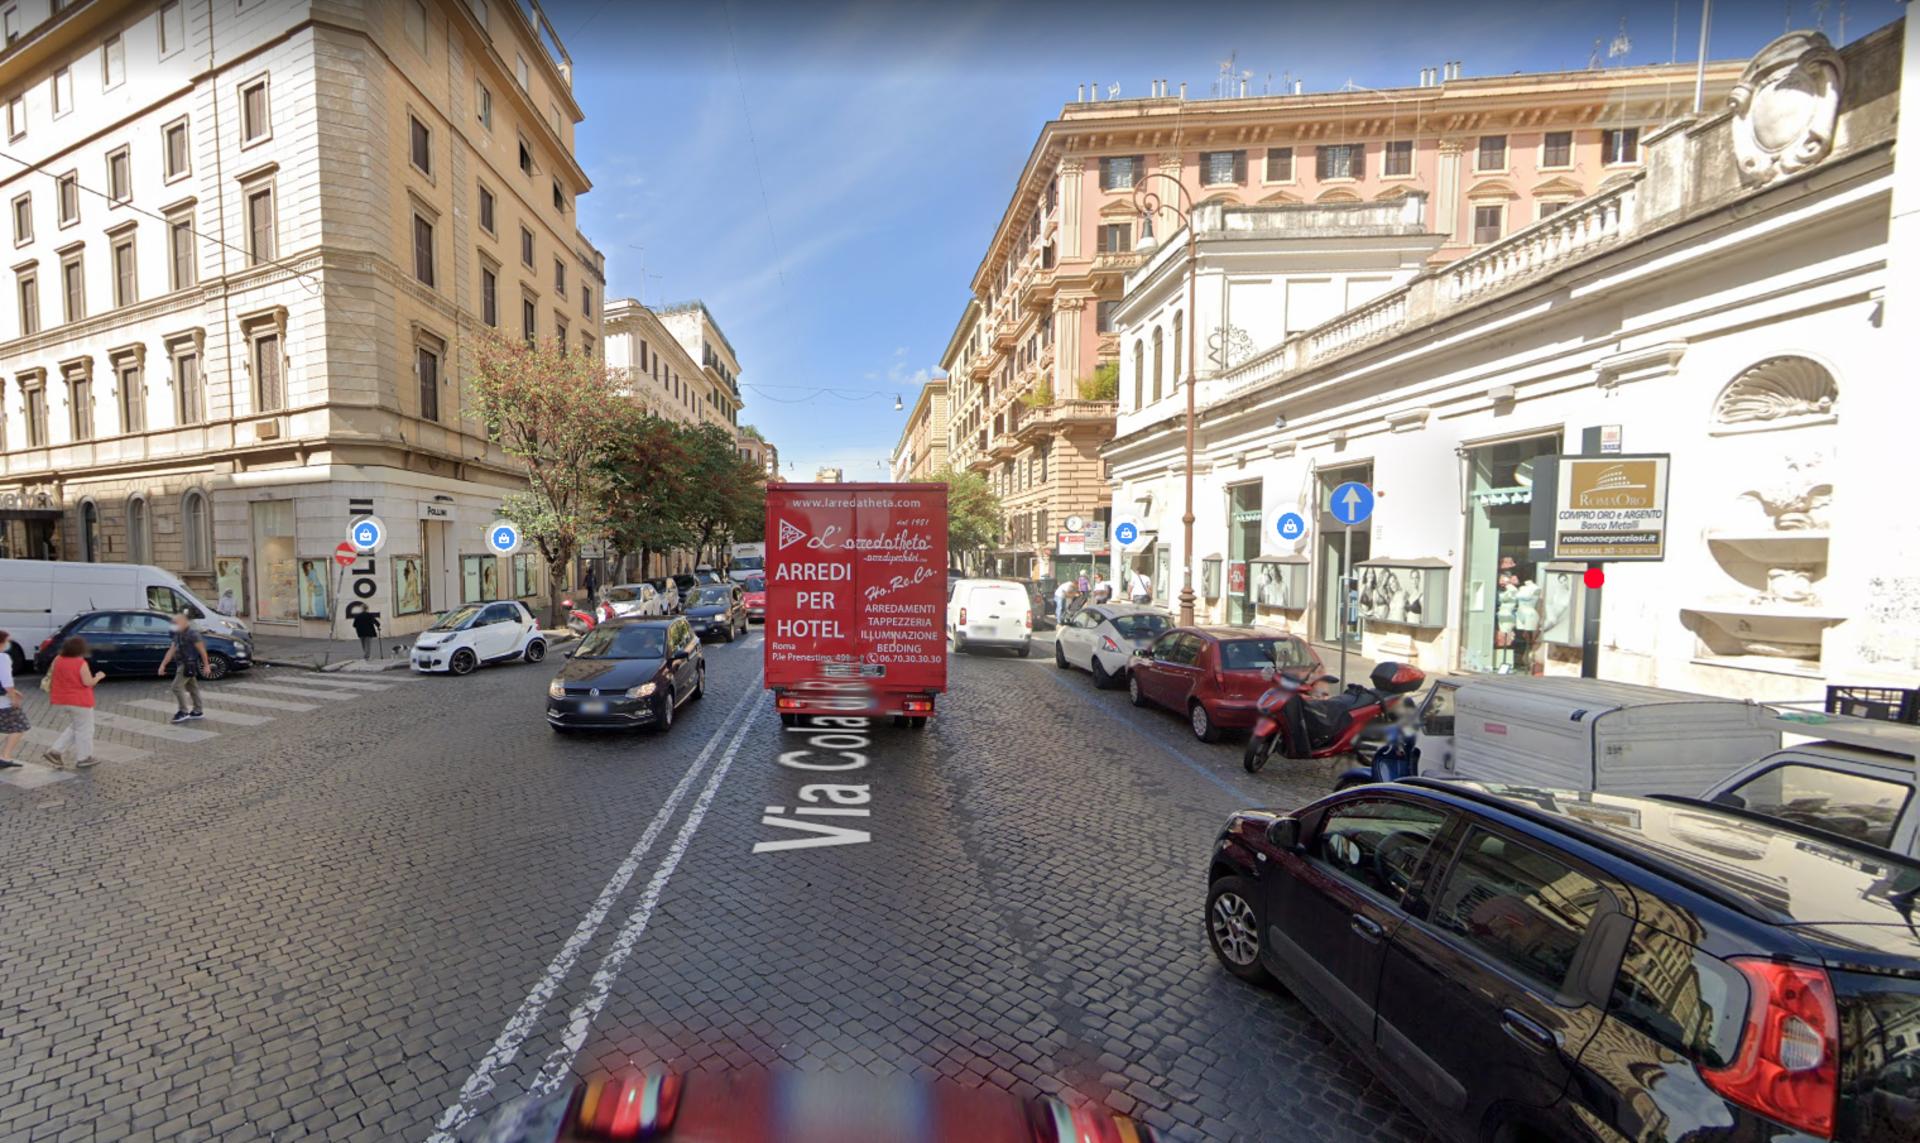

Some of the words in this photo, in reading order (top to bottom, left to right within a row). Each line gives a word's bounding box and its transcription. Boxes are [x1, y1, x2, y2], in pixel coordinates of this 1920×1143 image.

[1559, 511, 1595, 519] COMPRO
[1597, 511, 1616, 519] ORO
[1624, 510, 1662, 519] ARGENTO
[1581, 521, 1607, 529] Banco
[1609, 520, 1640, 529] Metalli
[346, 499, 380, 619] POLLNI
[775, 563, 851, 580] ARREDI
[796, 592, 835, 609] PER
[865, 604, 935, 613] ARREDAMENTI
[868, 617, 932, 626] TAPPEZZERIA
[777, 619, 845, 638] HOTEL
[861, 630, 938, 640] ILLUMINAZIONE
[772, 642, 796, 650] Roma
[877, 643, 922, 653] BEDDING
[772, 652, 785, 660] P.le
[880, 654, 942, 663] 06.70.30.30.30
